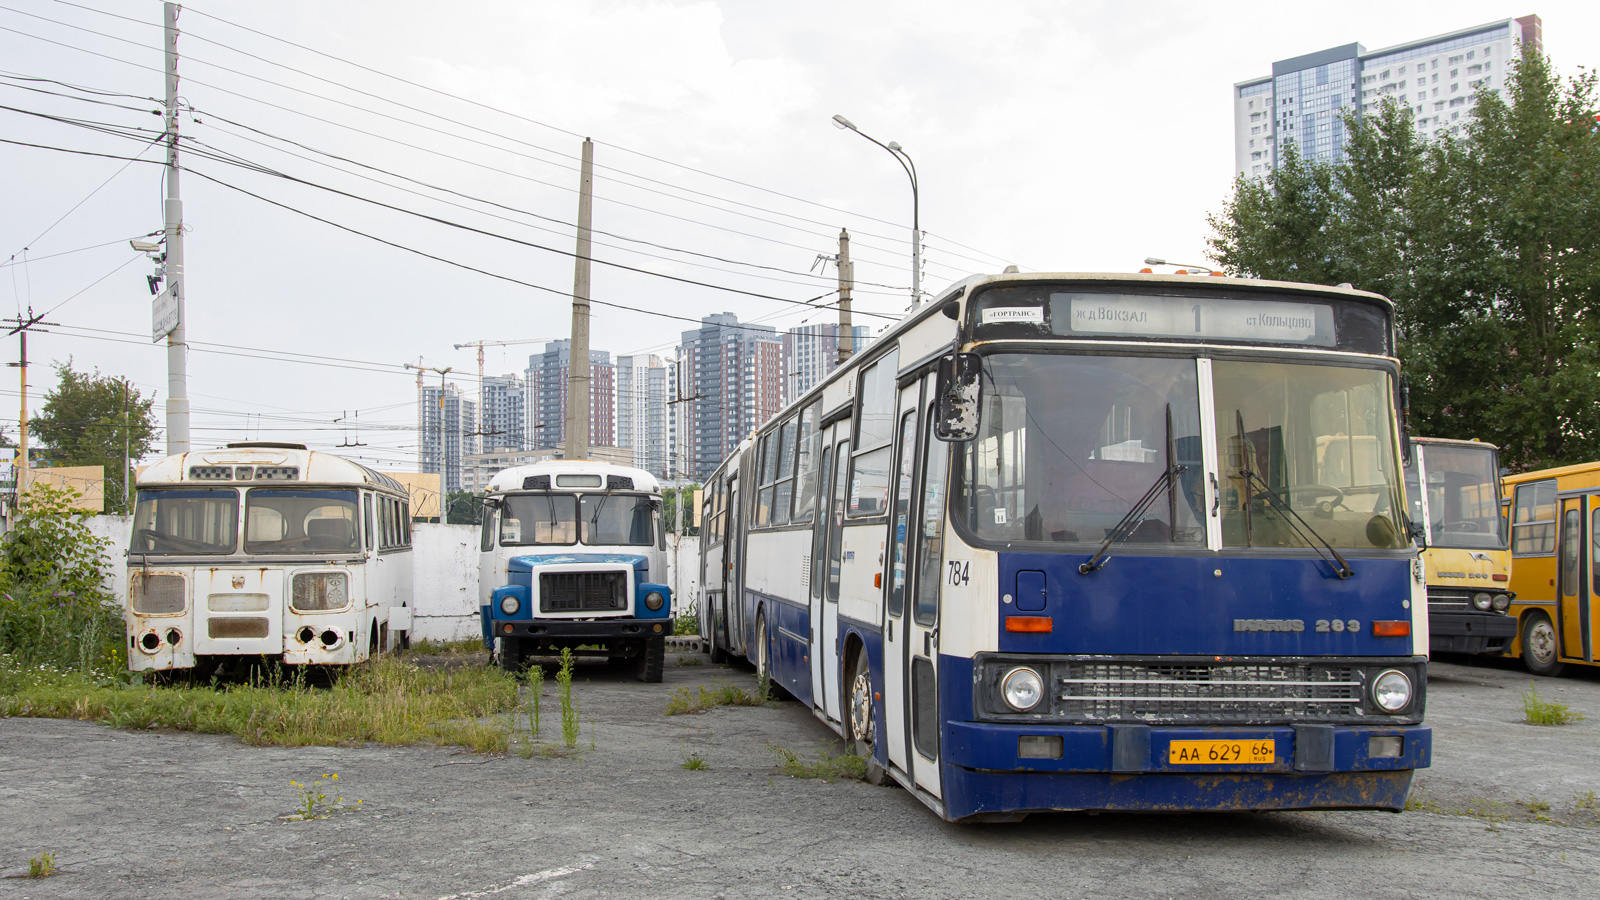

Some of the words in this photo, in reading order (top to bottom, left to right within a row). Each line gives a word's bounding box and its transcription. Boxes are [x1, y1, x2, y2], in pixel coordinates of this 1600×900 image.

[1192, 304, 1201, 333] 1
[948, 560, 970, 587] 784
[1233, 619, 1305, 633] IKARUS
[1315, 619, 1360, 633] 283
[1179, 747, 1200, 761] АА
[1208, 743, 1241, 761] 629
[1252, 742, 1269, 756] 66
